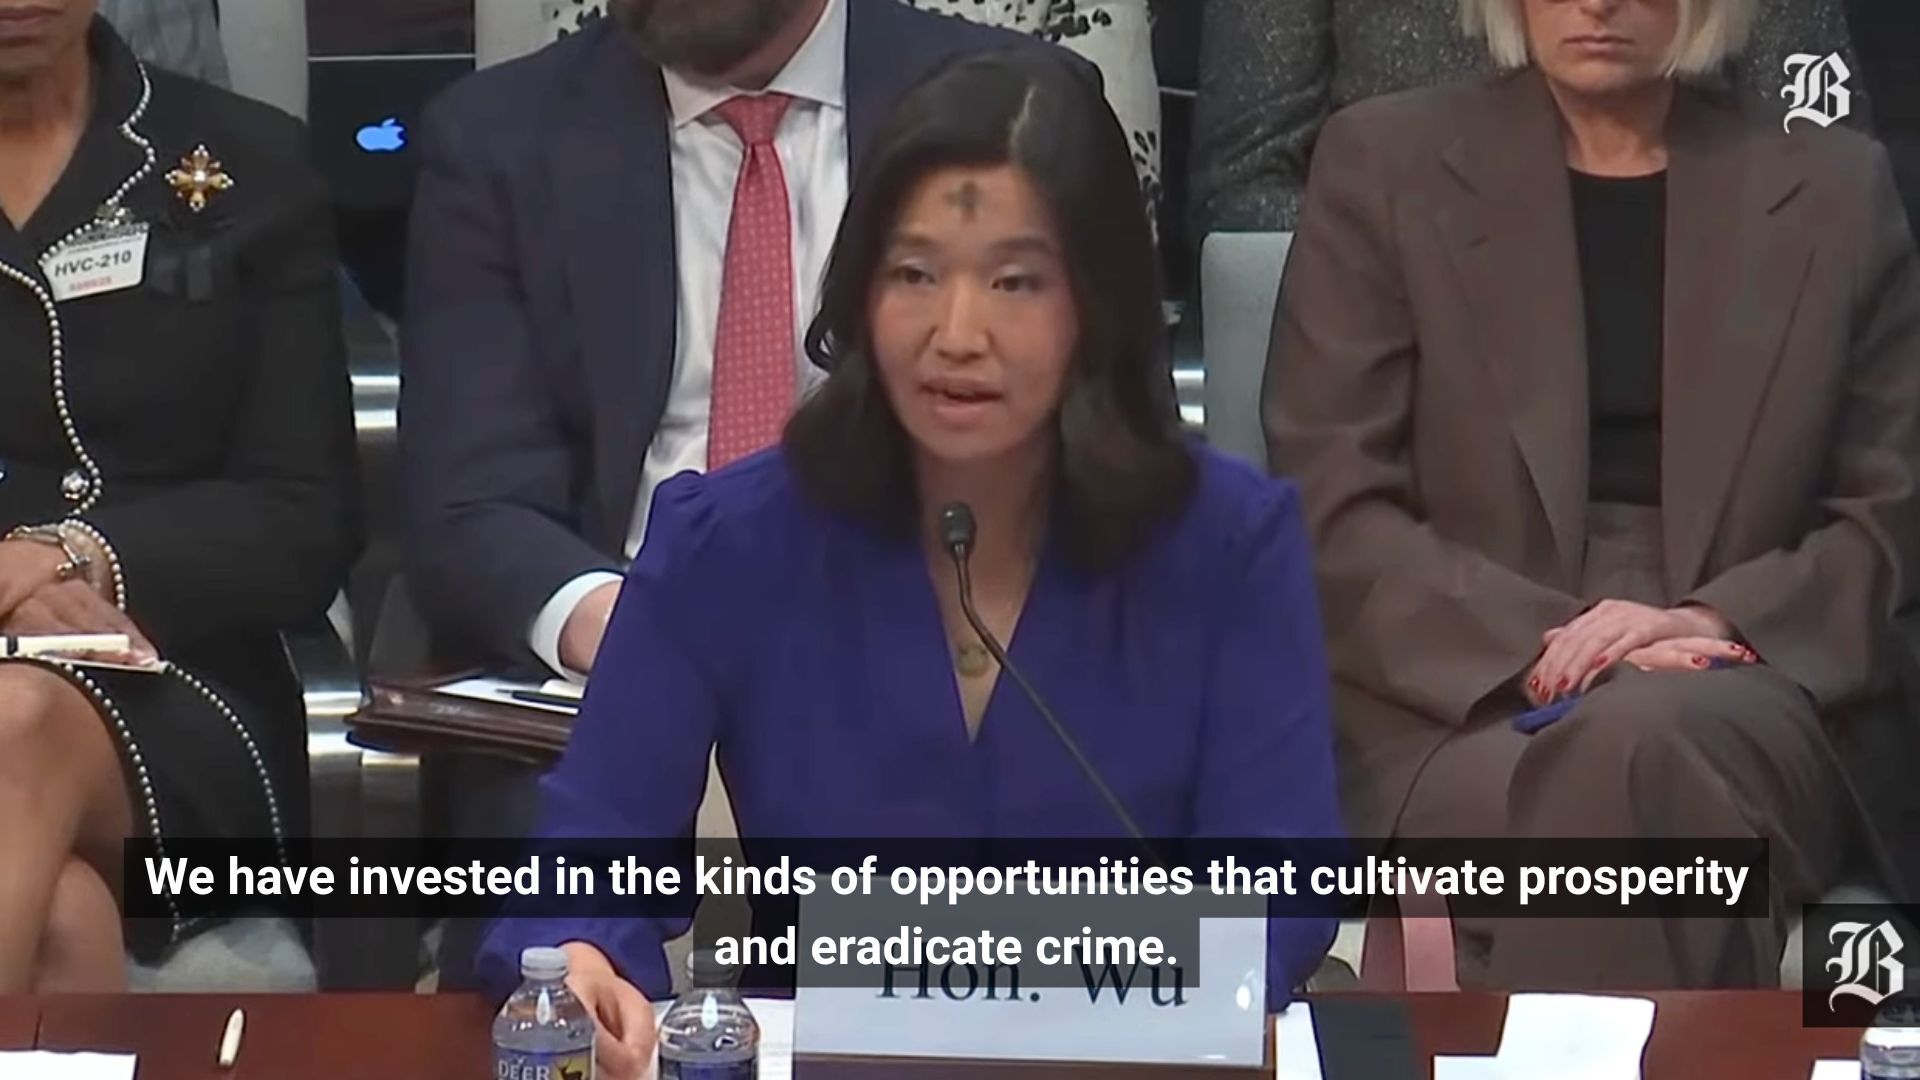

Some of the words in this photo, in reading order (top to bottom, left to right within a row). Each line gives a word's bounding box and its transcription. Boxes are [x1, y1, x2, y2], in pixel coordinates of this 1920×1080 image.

[54, 250, 132, 277] HVC-210
[875, 940, 1040, 1000] Hon.
[1071, 943, 1188, 1006] Wu
[498, 1059, 550, 1080] DEER
